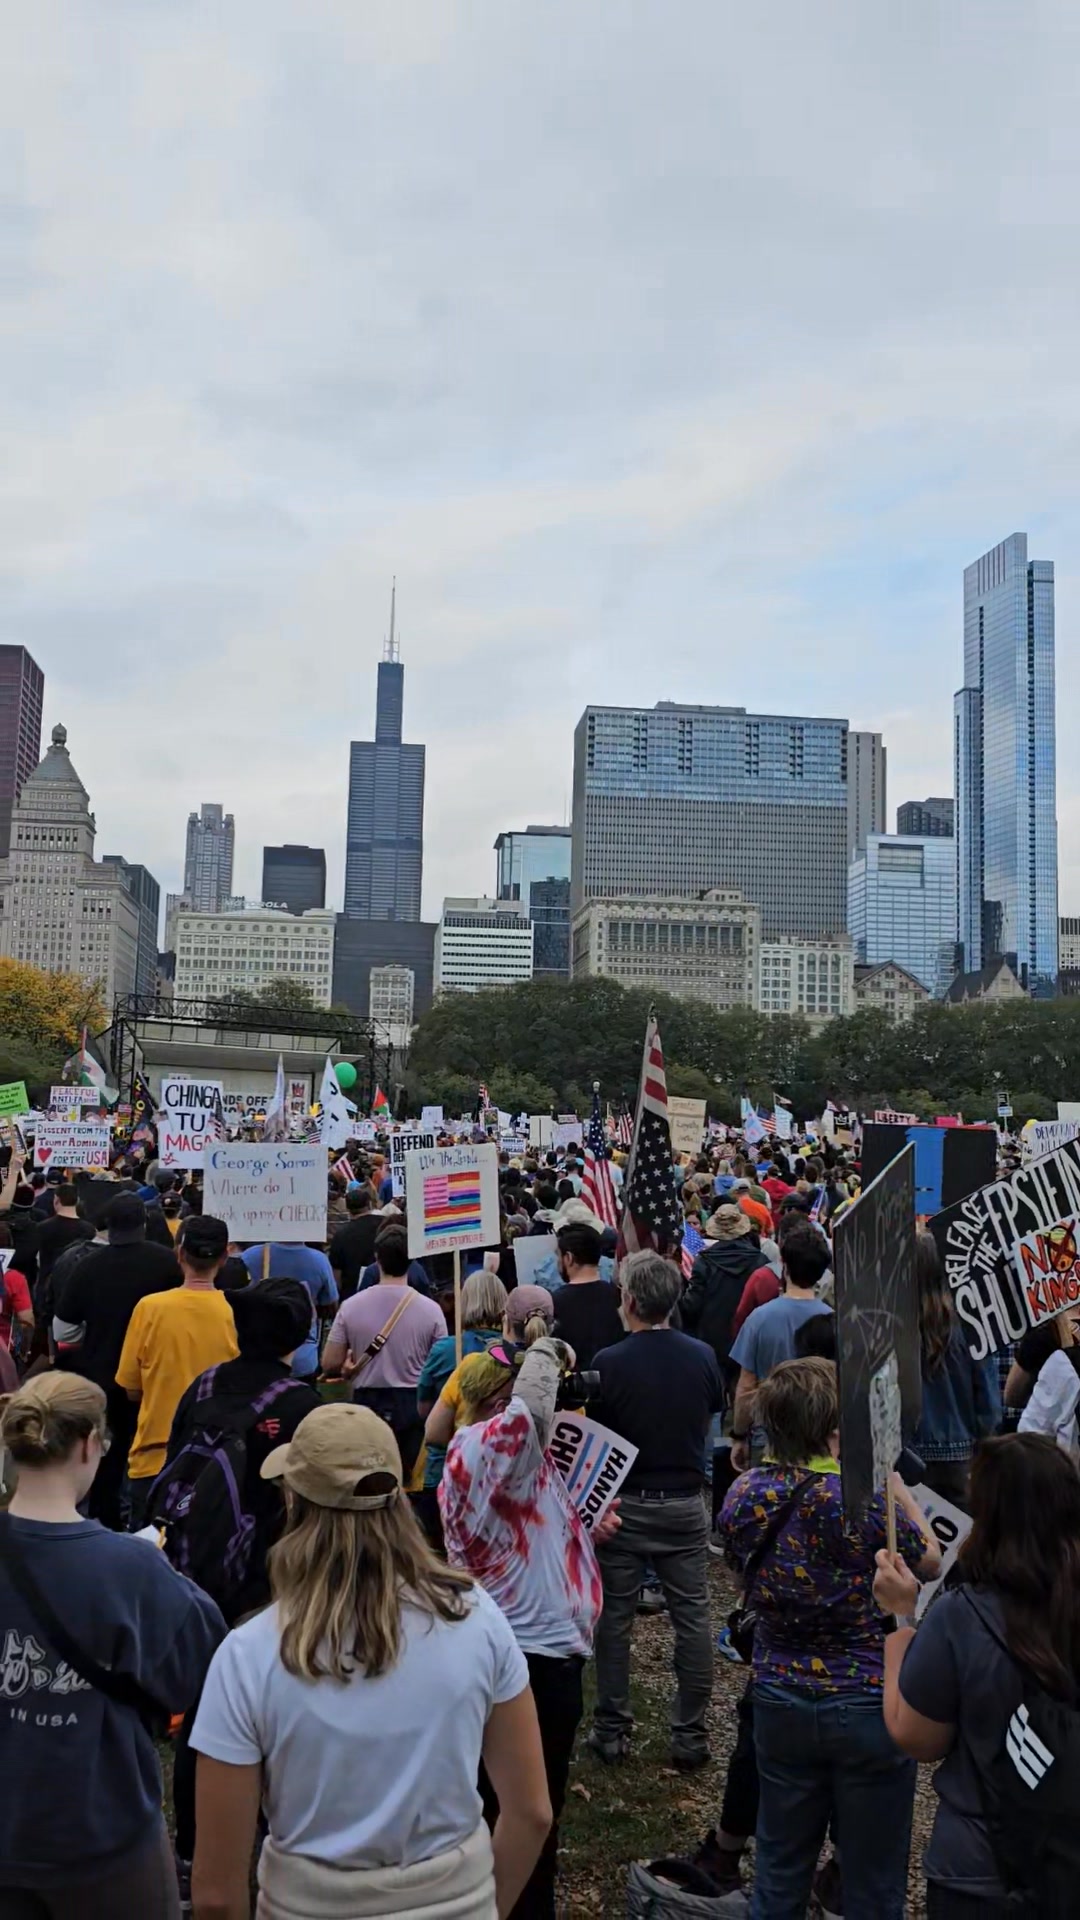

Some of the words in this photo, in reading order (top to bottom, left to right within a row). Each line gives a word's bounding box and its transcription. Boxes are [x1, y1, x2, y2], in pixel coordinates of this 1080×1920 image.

[165, 1085, 222, 1109] CHINGA
[222, 1095, 243, 1105] NDS
[246, 1096, 268, 1106] OFF
[175, 1113, 206, 1132] TU
[166, 1134, 212, 1152] MAGA
[393, 1134, 434, 1153] DEFEND
[87, 1151, 108, 1165] USA
[212, 1150, 270, 1177] George
[211, 1179, 258, 1195] Where
[264, 1177, 280, 1194] do
[290, 1176, 295, 1194] I
[946, 1192, 990, 1289] RELEASE
[972, 1231, 1002, 1273] THE
[579, 1446, 628, 1530] HANDS
[36, 1712, 78, 1727] USA
